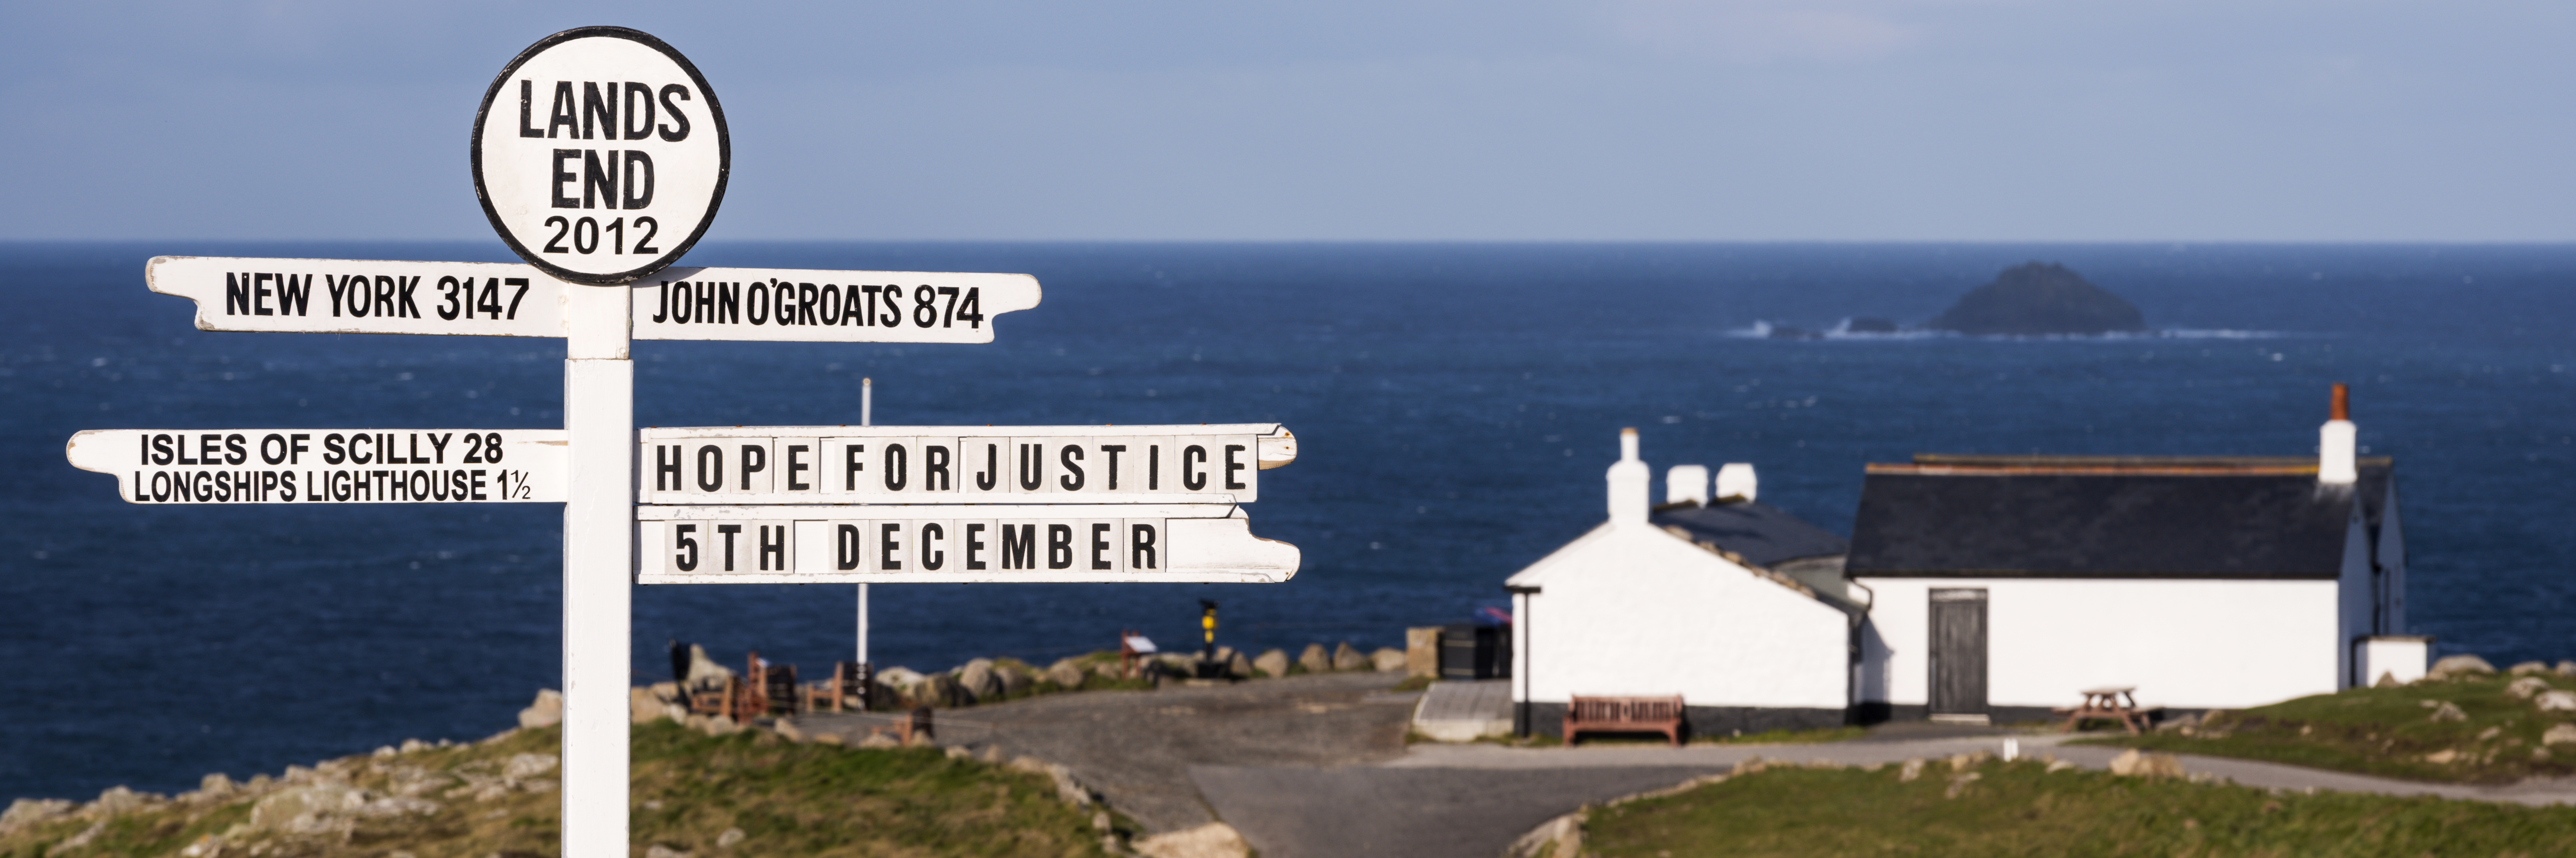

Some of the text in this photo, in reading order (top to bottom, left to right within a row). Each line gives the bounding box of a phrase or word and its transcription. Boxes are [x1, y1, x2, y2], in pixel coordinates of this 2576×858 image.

[520, 80, 691, 142] LANDS
[552, 149, 654, 210] END
[543, 216, 658, 255] 2012
[226, 272, 529, 320] NEW YORK 3147
[653, 280, 740, 324] JOHN
[913, 284, 984, 329] 874
[142, 433, 503, 465] ISLES OF SCILLY 28
[657, 443, 1246, 492] HOPE FOR JUSTICE
[135, 471, 296, 502] LONGSHIPS
[307, 470, 487, 502] LIGHTHOUSE
[676, 523, 1156, 572] 5TH DECEMBER
